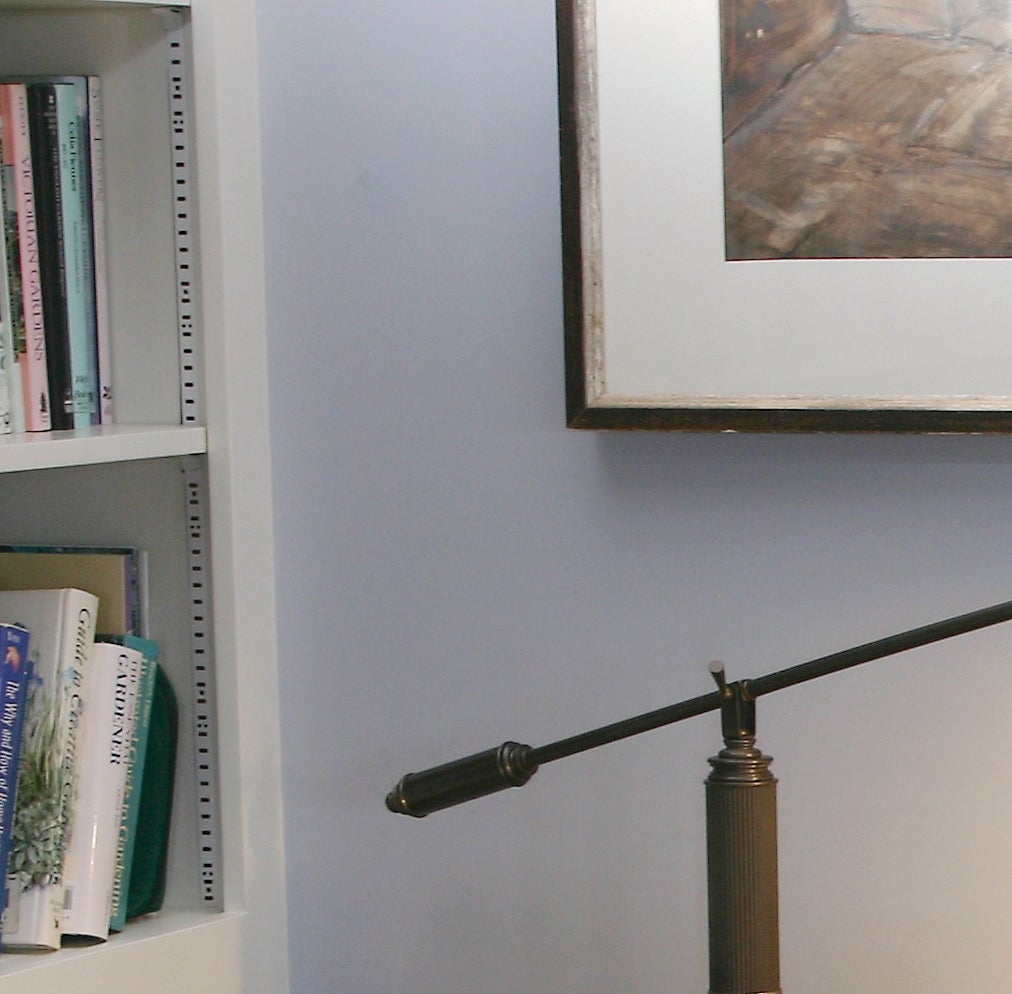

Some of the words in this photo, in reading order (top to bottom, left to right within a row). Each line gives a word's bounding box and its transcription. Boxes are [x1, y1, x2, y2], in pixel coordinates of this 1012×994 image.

[21, 156, 38, 263] VICTORIAN
[30, 269, 43, 361] GARDENS
[75, 608, 91, 665] Guide
[73, 668, 84, 687] to
[5, 681, 20, 700] The
[2, 703, 18, 727] Why
[110, 653, 128, 765] GARDENER
[1, 728, 13, 749] and
[0, 750, 12, 776] How
